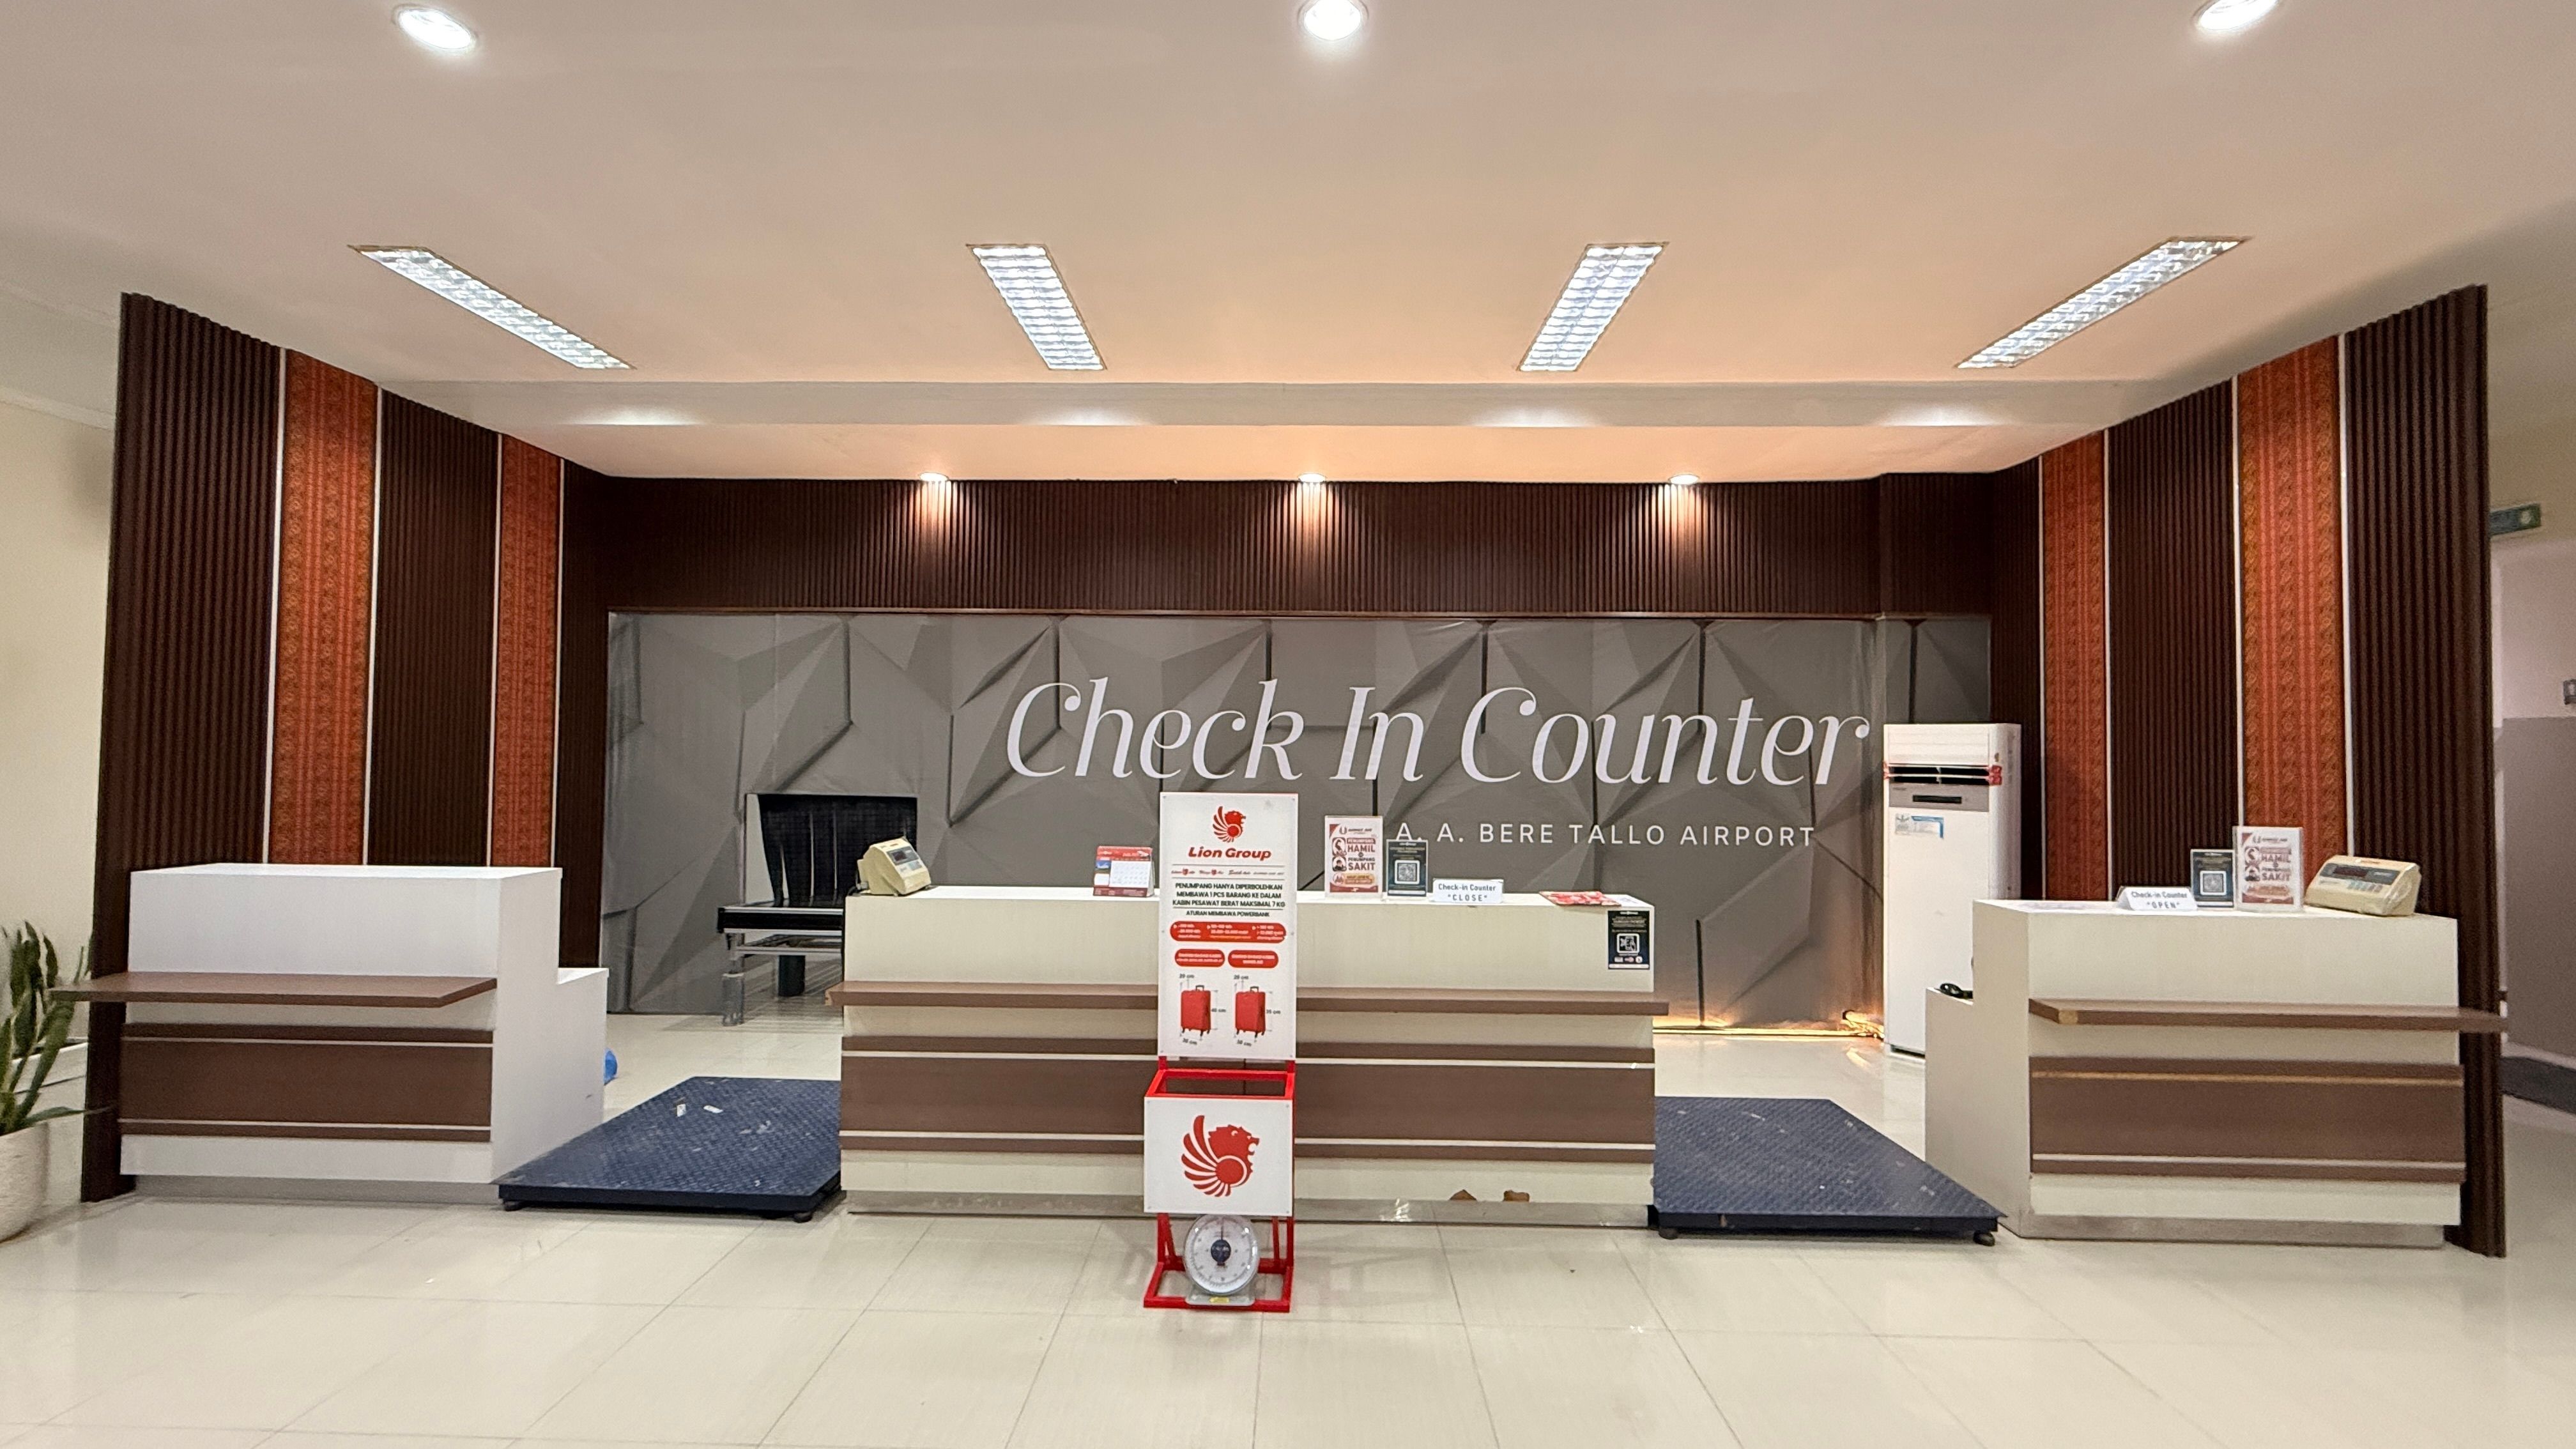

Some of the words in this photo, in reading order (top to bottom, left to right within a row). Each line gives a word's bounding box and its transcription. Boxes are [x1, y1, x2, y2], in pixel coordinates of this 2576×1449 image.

[1006, 677, 1305, 780] Check
[1328, 686, 1425, 782] In
[1460, 687, 1870, 786] Counter
[1436, 823, 1464, 843] A.
[1479, 824, 1553, 843] BERE
[1569, 824, 1665, 845] TALLO
[1680, 825, 1814, 847] AIRPORT
[1188, 846, 1223, 858] Lion
[1225, 847, 1272, 861] Group
[1347, 845, 1376, 853] HAMIL
[1348, 862, 1376, 871] SAKIT
[2262, 873, 2290, 881] SAKIT
[1438, 883, 1468, 891] Check-in
[1469, 884, 1496, 892] Counter
